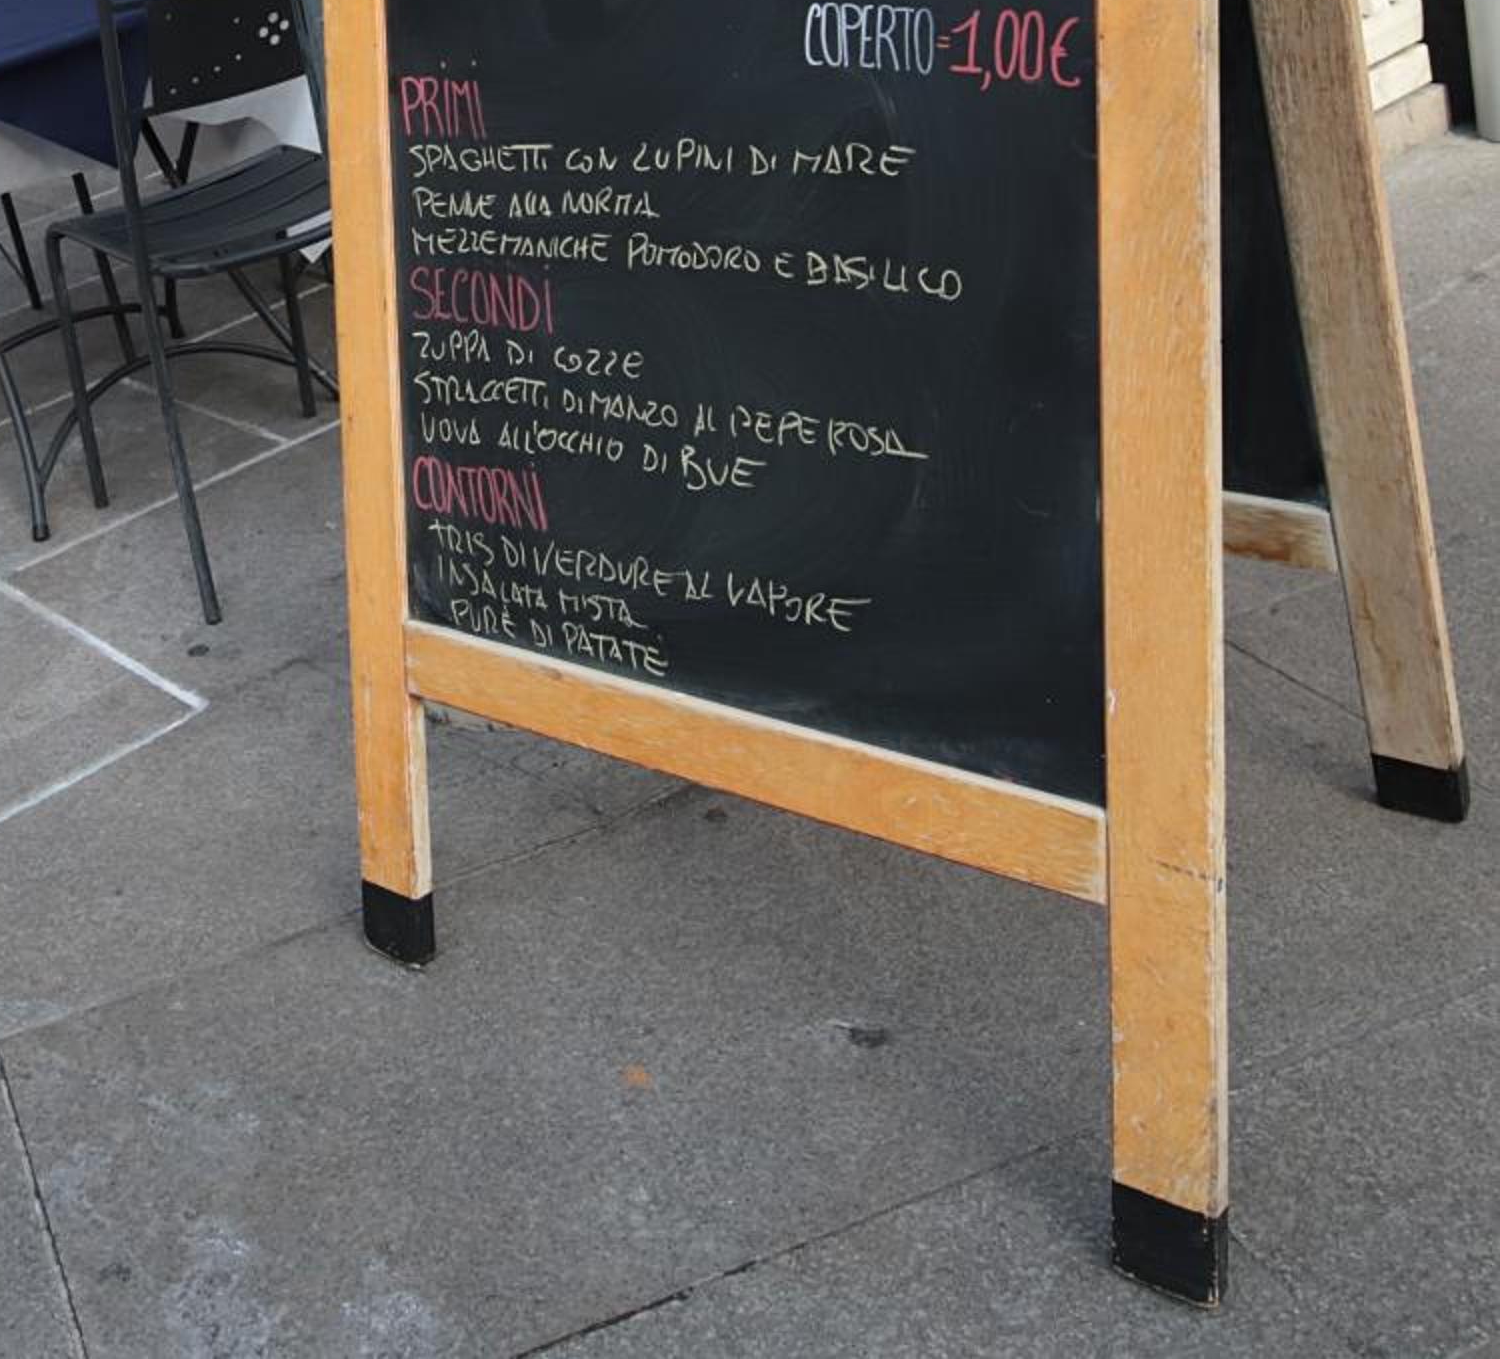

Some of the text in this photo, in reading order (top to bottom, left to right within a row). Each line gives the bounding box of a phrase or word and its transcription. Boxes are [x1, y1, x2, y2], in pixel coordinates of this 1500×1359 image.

[804, 1, 935, 75] COPERTO
[400, 75, 487, 140] PRIMI
[409, 143, 553, 178] SPAGHETTI
[565, 146, 618, 174] CON
[749, 144, 777, 175] DI
[793, 142, 916, 176] MARE
[412, 186, 660, 219] PENNE ALLA NORMA
[410, 264, 553, 335] SECONDI
[627, 232, 761, 271] POMODORO
[775, 252, 795, 278] E
[806, 250, 963, 301] BASILICO
[412, 329, 491, 363] ZUPPA
[506, 340, 533, 366] DI
[414, 371, 549, 409] STRACCETTI
[589, 390, 678, 428] MANZO
[693, 402, 717, 438] AL
[731, 404, 820, 447] PEPE
[828, 418, 930, 460] ROSA
[421, 412, 481, 446] UOVA
[643, 444, 667, 473] DI
[680, 444, 767, 490] BUE
[412, 455, 548, 531] CONTORNI
[428, 518, 872, 632] TRIS DI VERDURE AL VAPORE
[438, 554, 649, 629] INSALATA MISTA
[531, 618, 553, 648] DI
[562, 621, 669, 677] PATATE
